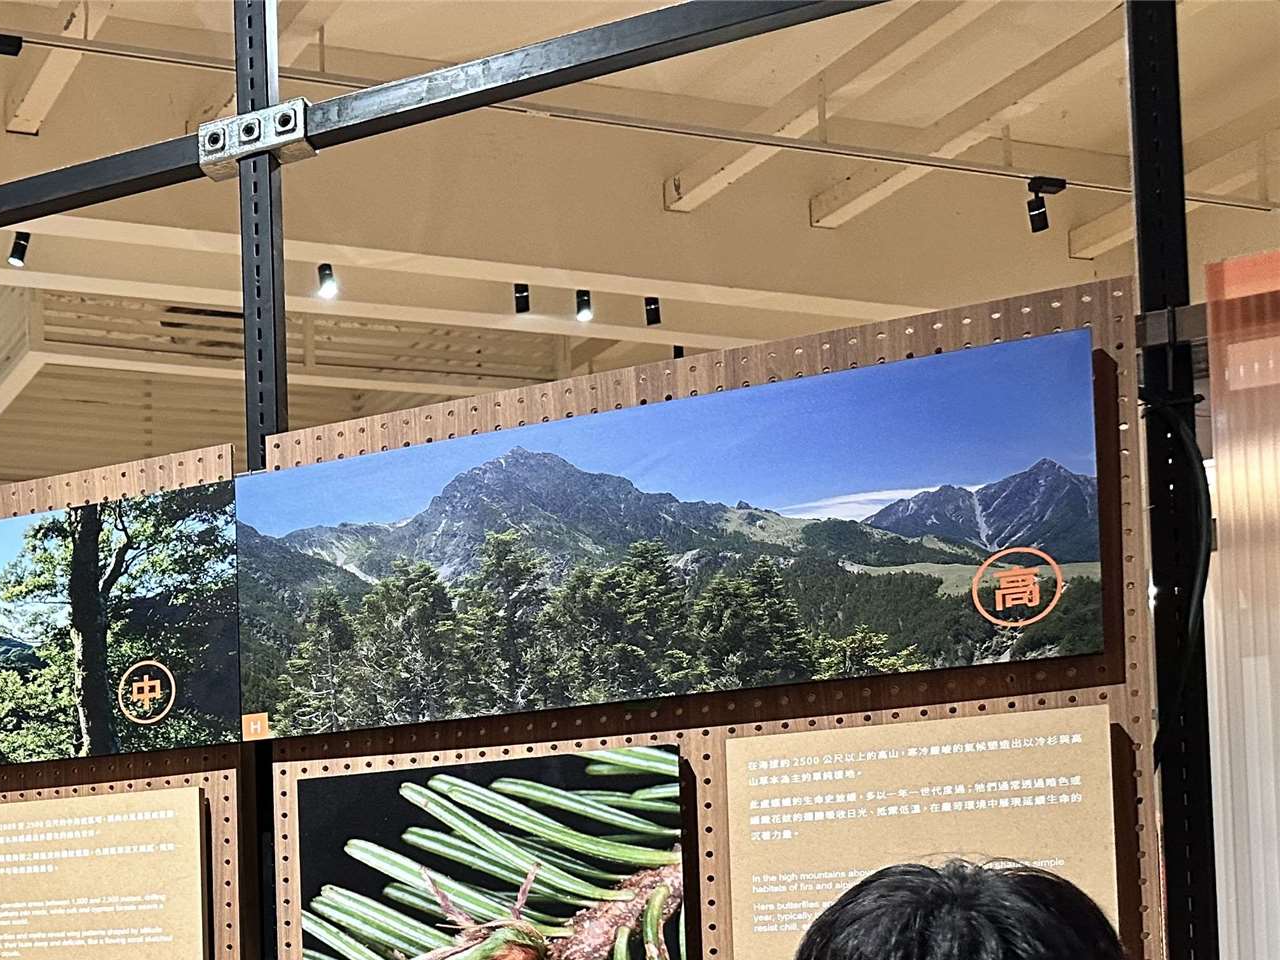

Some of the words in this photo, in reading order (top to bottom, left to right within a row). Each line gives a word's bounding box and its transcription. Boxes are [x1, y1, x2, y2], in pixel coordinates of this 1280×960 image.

[993, 566, 1041, 611] 高
[132, 674, 161, 710] 中
[249, 720, 261, 734] H
[793, 756, 820, 767] 2500
[752, 874, 761, 882] In
[763, 873, 777, 882] the
[778, 871, 799, 884] high
[800, 870, 846, 881] mountains
[848, 869, 871, 878] abov
[788, 882, 799, 892] of
[816, 880, 833, 890] and
[753, 902, 775, 912] Here
[777, 900, 820, 911] butterflies
[777, 911, 813, 923] typically
